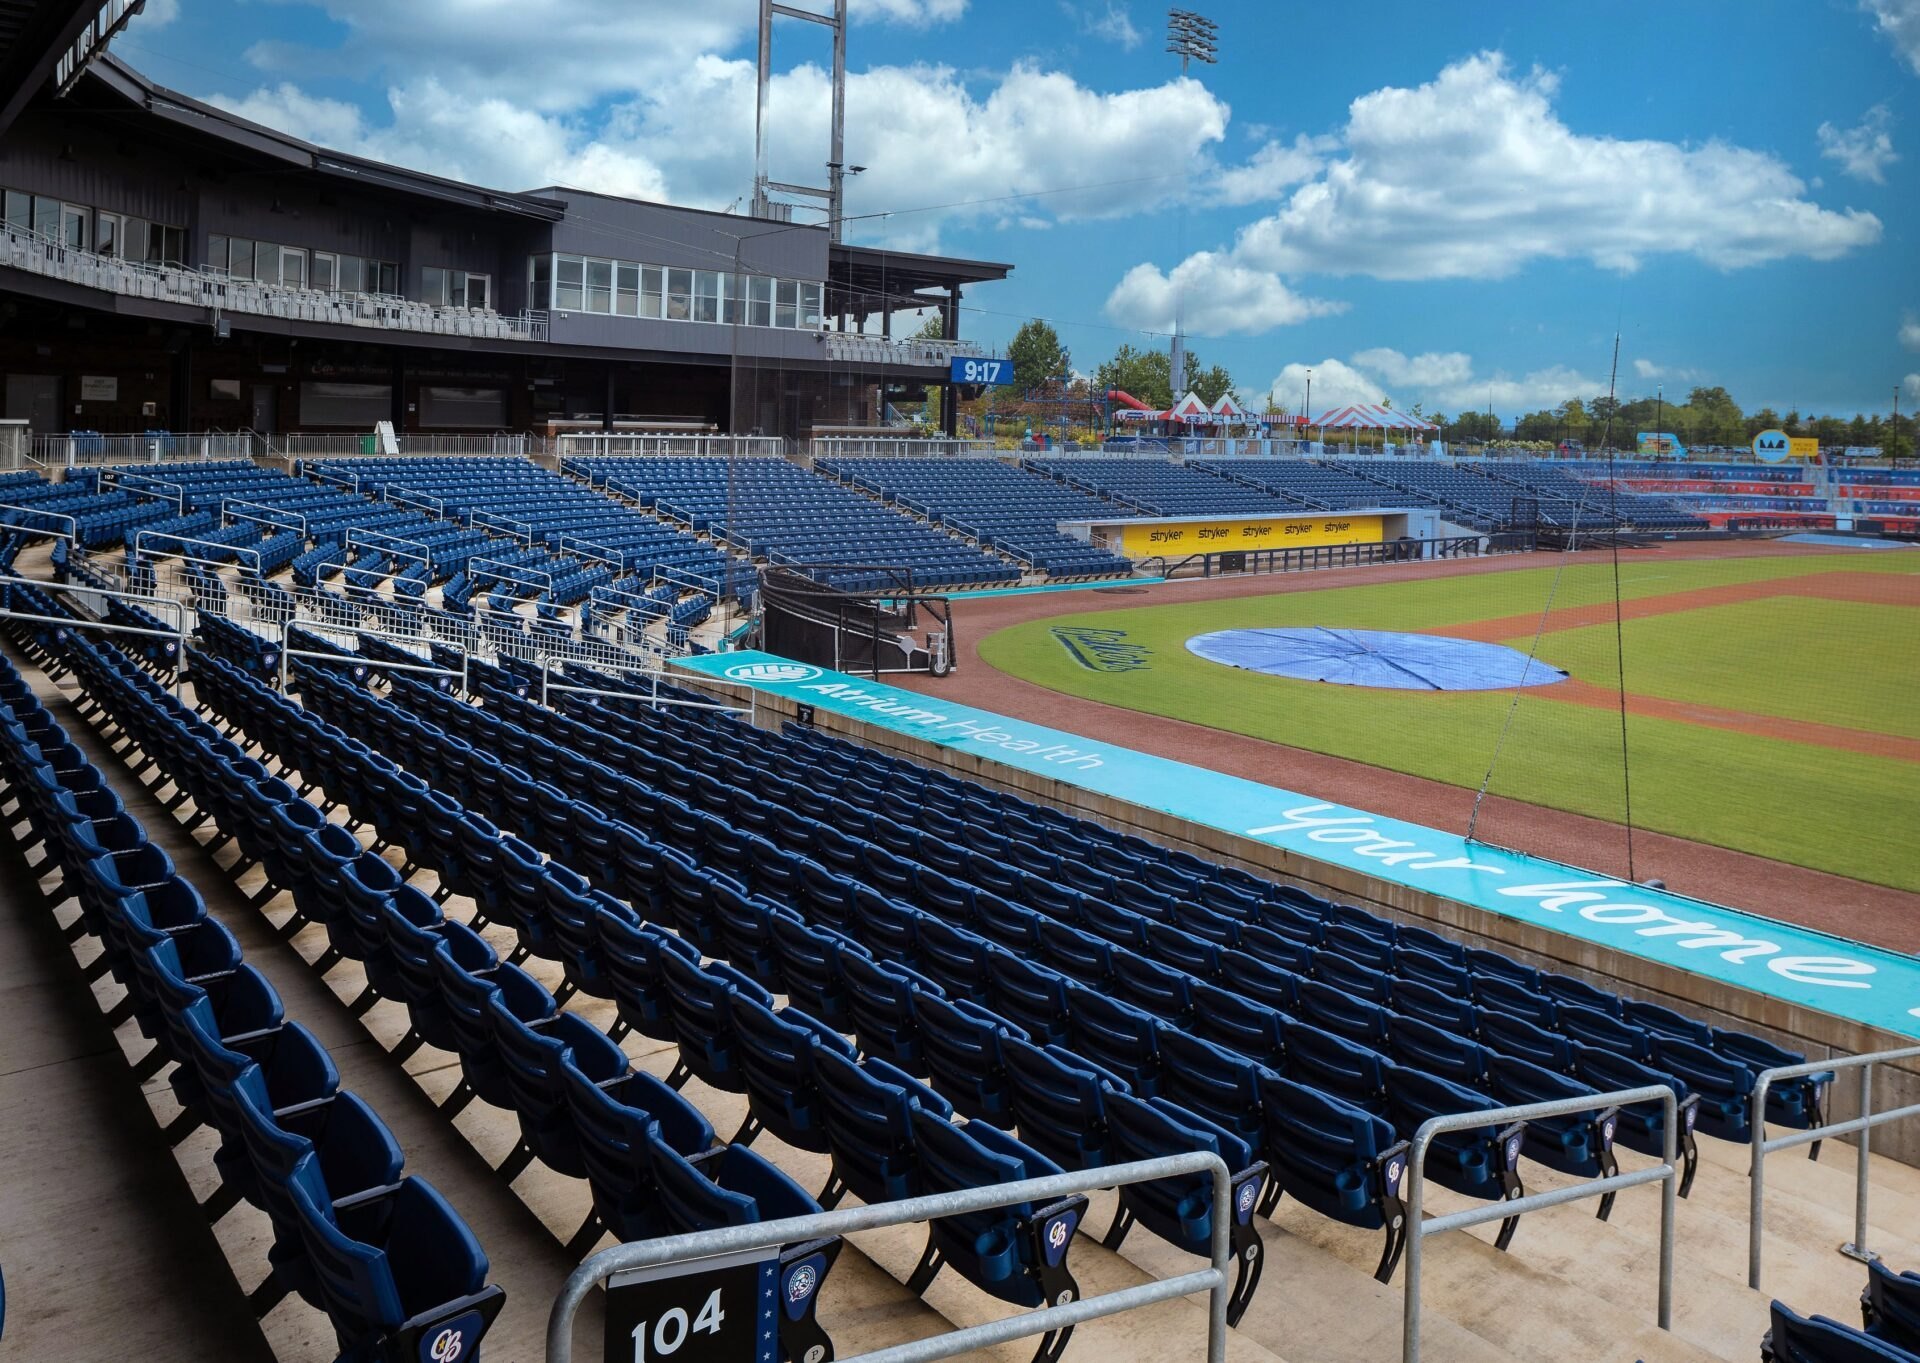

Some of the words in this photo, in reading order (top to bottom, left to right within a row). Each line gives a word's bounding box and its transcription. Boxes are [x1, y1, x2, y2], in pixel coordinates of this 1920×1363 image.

[964, 360, 1001, 383] 9:17
[1150, 529, 1184, 542] stryker
[1198, 527, 1230, 540] stryker
[1242, 525, 1272, 538] stryker
[1284, 523, 1313, 536] stryker
[1324, 521, 1351, 534] stryker
[797, 683, 947, 725] Atrium
[937, 719, 1104, 770] Health
[1497, 880, 1878, 989] home
[1061, 1293, 1069, 1304] N
[631, 1288, 725, 1363] 104
[810, 1349, 820, 1360] P
